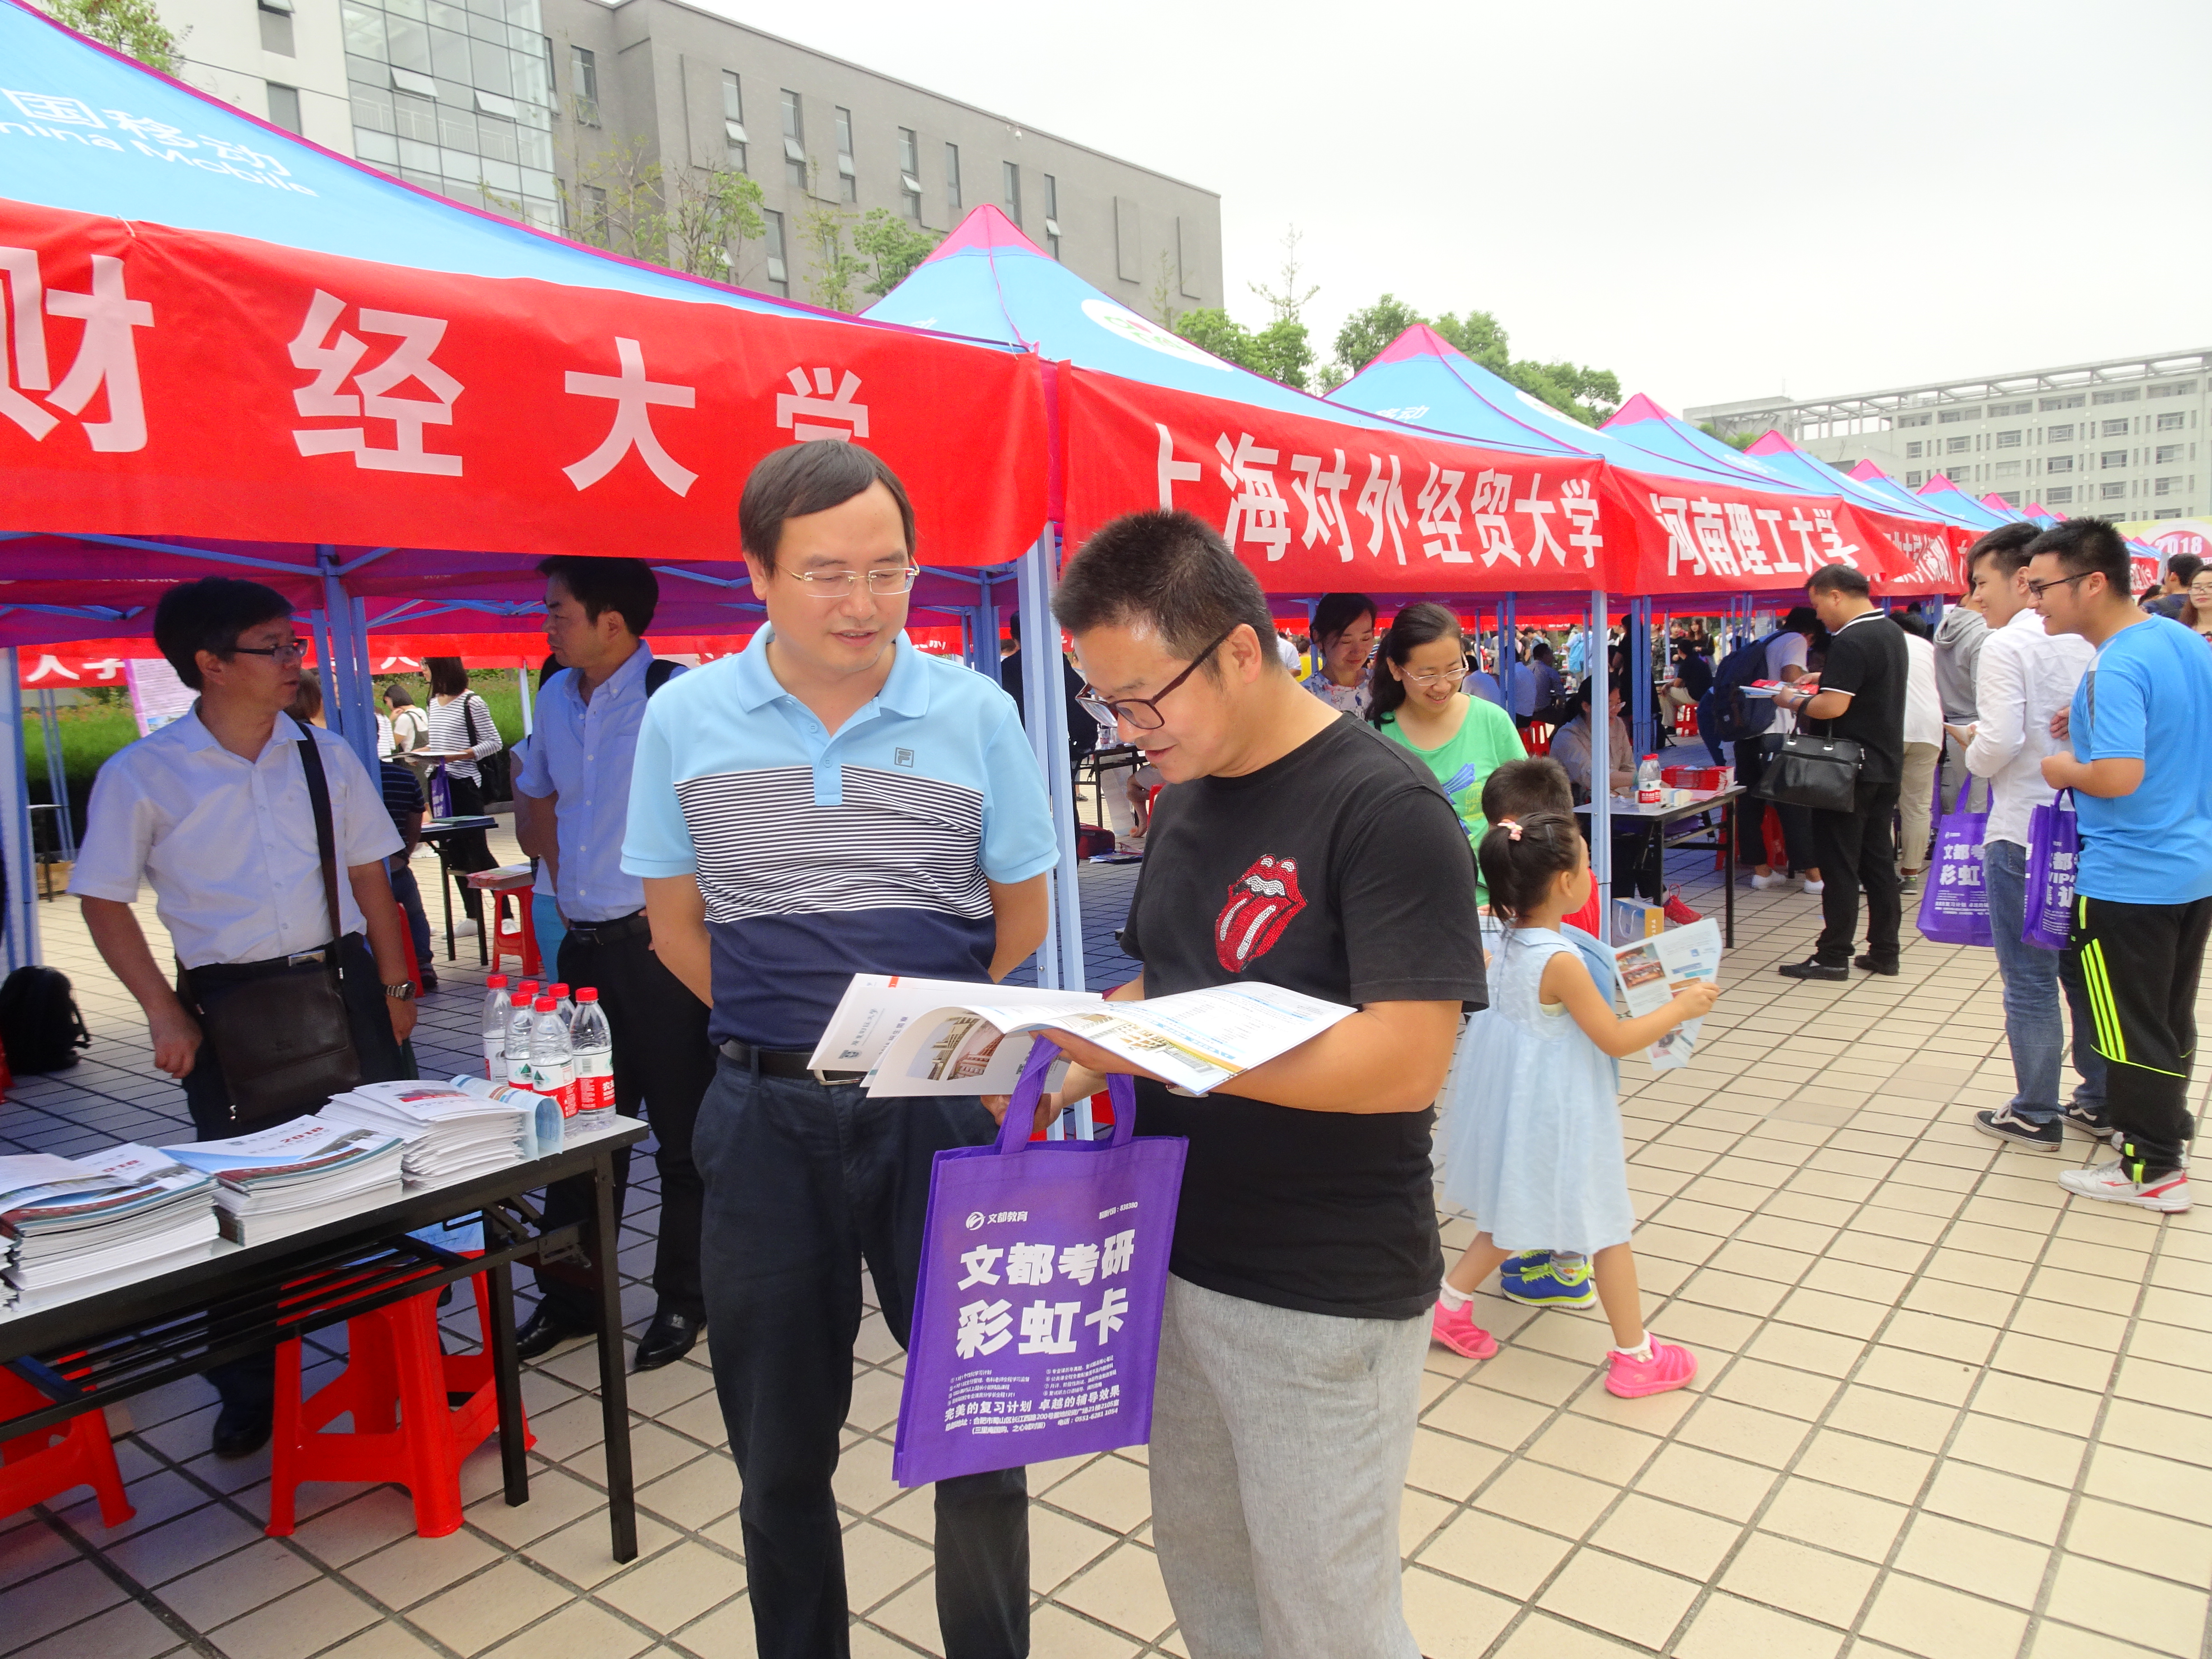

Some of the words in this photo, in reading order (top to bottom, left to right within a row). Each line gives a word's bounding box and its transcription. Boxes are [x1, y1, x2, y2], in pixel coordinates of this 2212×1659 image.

[130, 139, 319, 197] Mobile
[1155, 422, 1603, 568] 上海对外经贸大学
[1649, 493, 1861, 576] 河南理工大学
[2155, 535, 2203, 555] 2018
[1940, 864, 1985, 886] 彩虹
[987, 1211, 1028, 1224] 文都教育
[957, 1228, 1135, 1291] 文都考研
[956, 1288, 1129, 1359] 彩虹卡
[945, 1400, 1032, 1422] 完美的复习计划
[1039, 1384, 1120, 1411] 卓越的辅导效果
